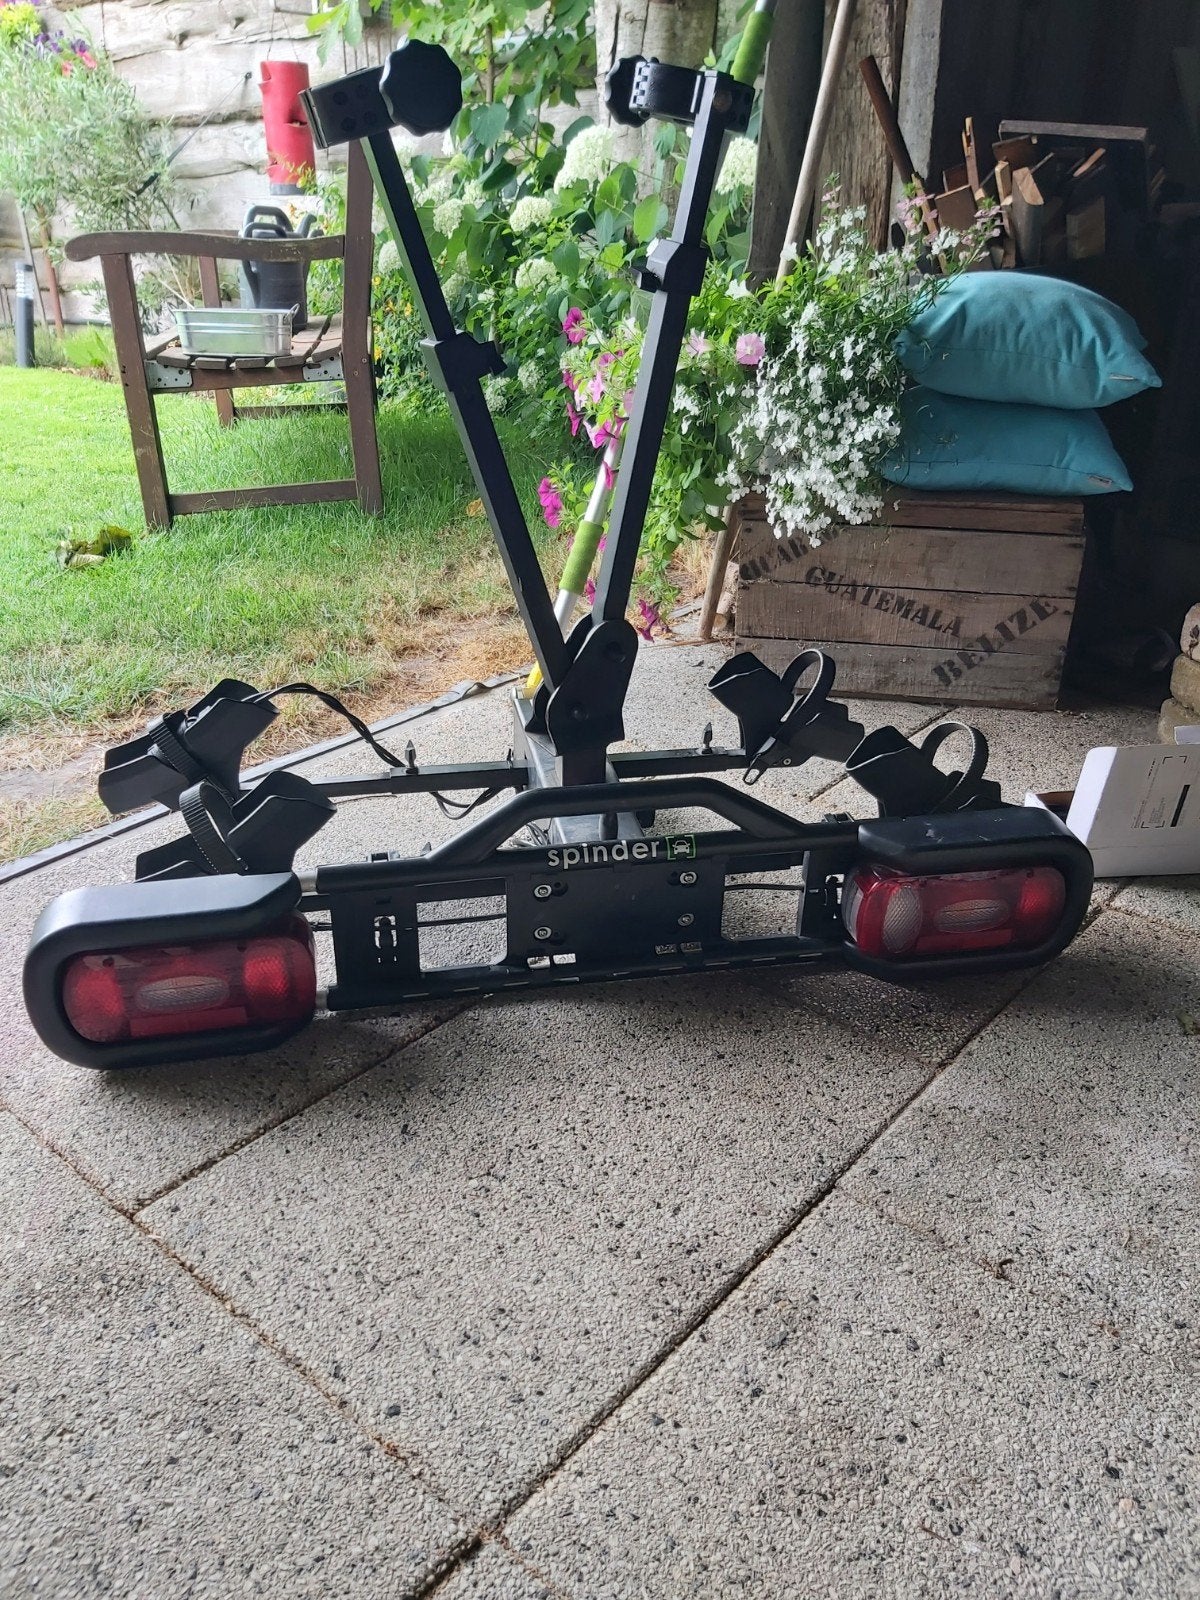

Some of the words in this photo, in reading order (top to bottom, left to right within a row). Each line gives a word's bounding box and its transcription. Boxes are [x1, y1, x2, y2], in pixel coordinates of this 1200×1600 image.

[804, 565, 962, 638] GUATEMALA
[931, 597, 1059, 687] BELIZE
[547, 839, 660, 870] spinder
